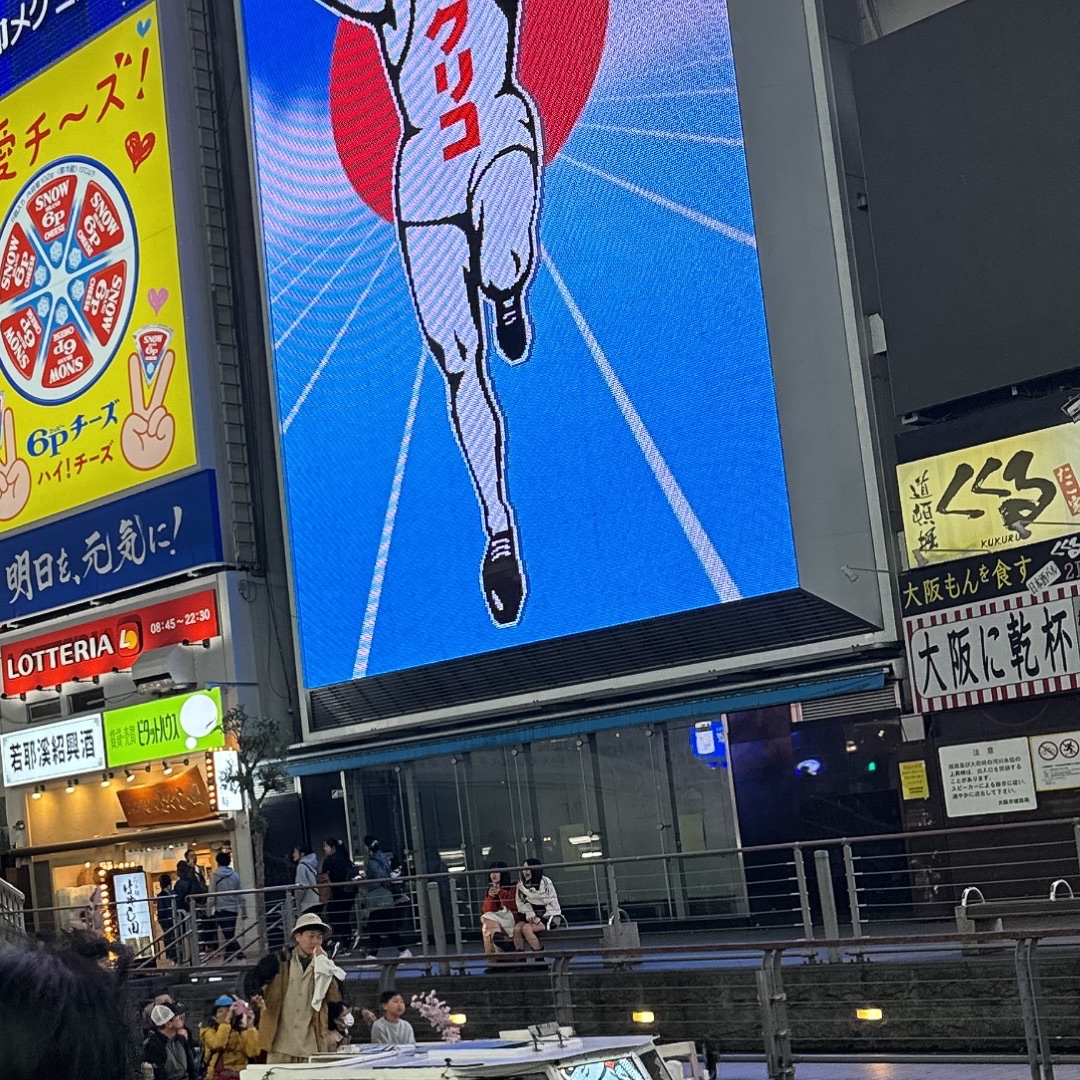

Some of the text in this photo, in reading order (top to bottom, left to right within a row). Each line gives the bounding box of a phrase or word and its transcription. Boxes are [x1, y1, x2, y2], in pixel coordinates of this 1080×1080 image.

[35, 180, 70, 211] SNOW
[90, 192, 120, 236] SNOW
[42, 210, 66, 228] 6P
[84, 215, 101, 246] 6P
[1, 234, 20, 291] SNOW
[14, 251, 30, 287] 6P
[91, 279, 107, 316] 6P
[101, 275, 123, 335] SNOW
[3, 326, 31, 369] SNOW
[20, 317, 36, 348] 6P
[53, 338, 77, 355] 6P
[49, 356, 84, 384] SNOW
[936, 449, 1057, 539] くくる
[903, 555, 1033, 610] 大阪もんを食す
[7, 634, 114, 680] LOTTERIA
[918, 605, 1073, 696] 大阪に乾杯
[137, 713, 180, 747] ピタットハウス
